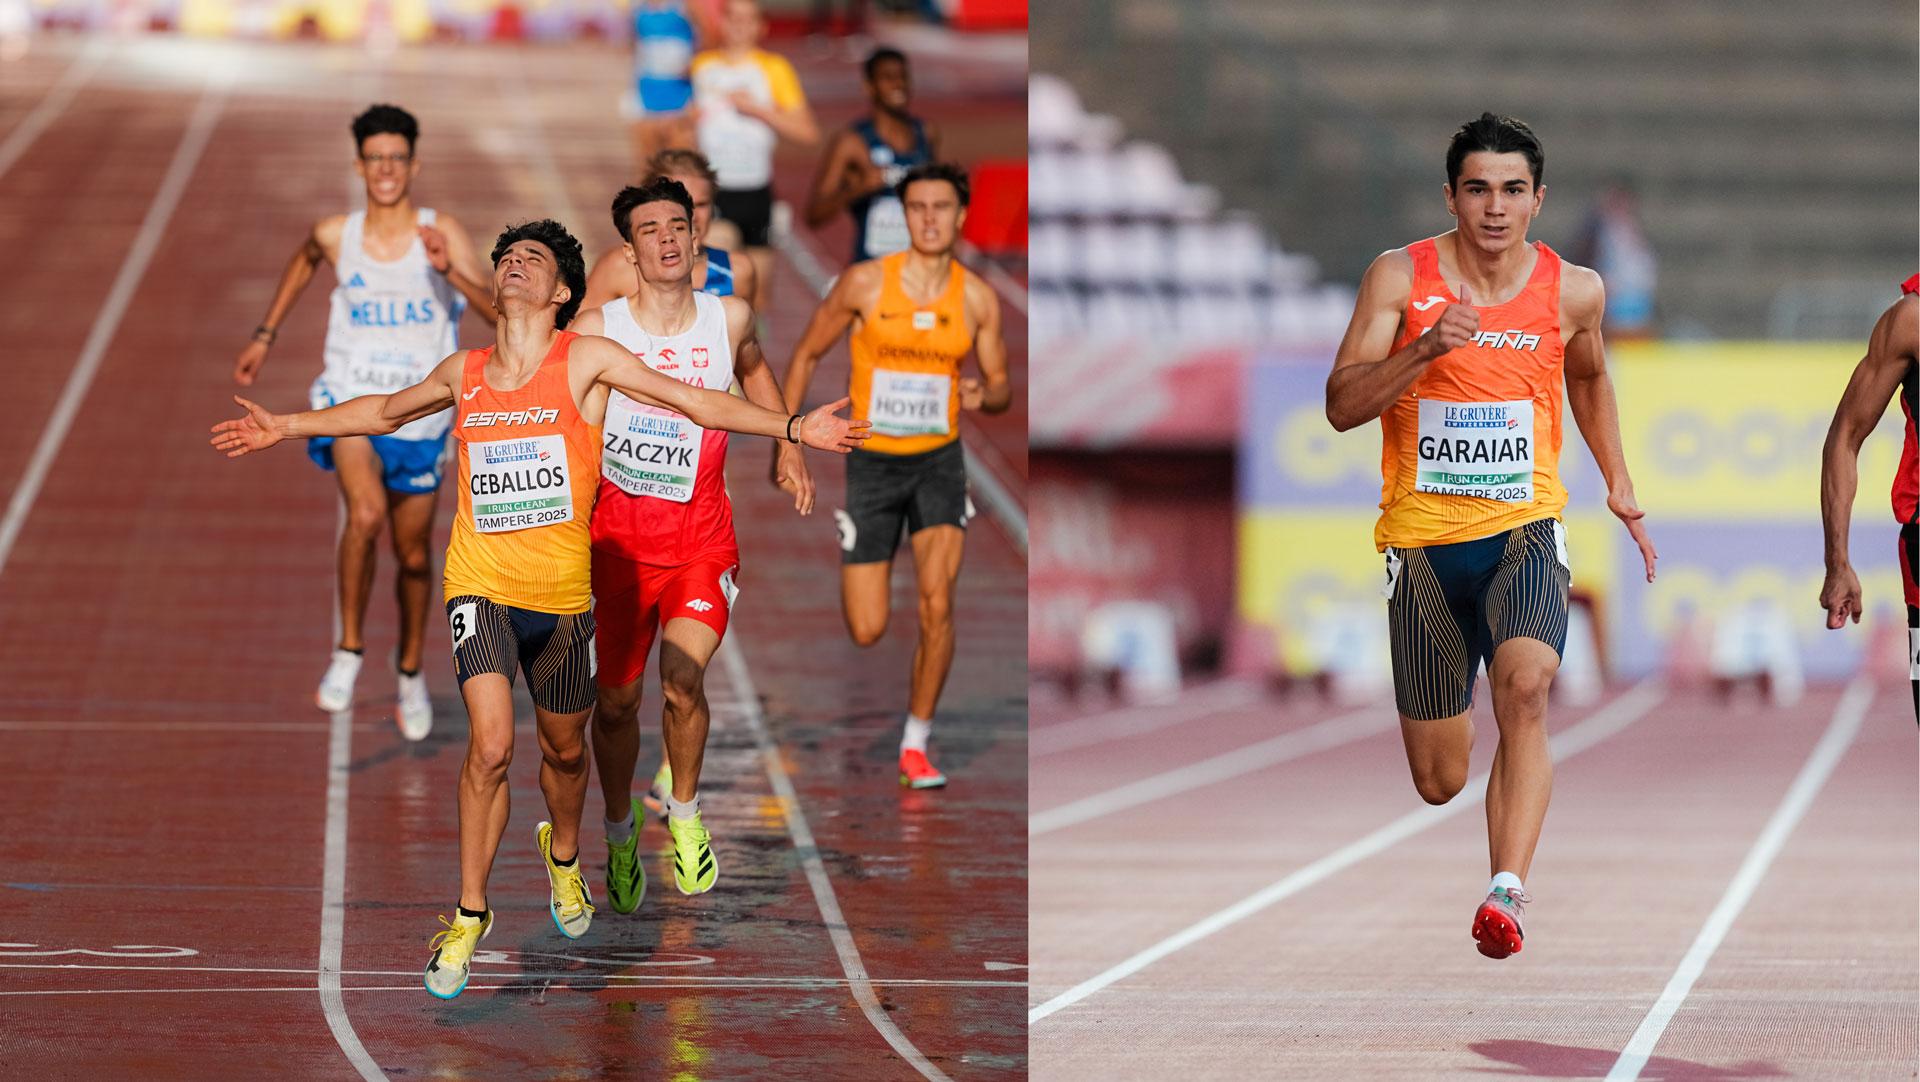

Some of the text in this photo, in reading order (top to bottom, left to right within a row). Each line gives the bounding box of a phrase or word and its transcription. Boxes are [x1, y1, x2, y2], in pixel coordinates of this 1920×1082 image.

[463, 406, 560, 428] ESPAÑA
[876, 397, 940, 419] HOYER
[1445, 405, 1507, 420] LE GRUYÈRE
[630, 415, 640, 426] LE
[484, 446, 493, 457] LE
[605, 432, 693, 467] ZACZYK
[1419, 436, 1528, 463] GARAIAR
[471, 466, 564, 495] CEBALLOS
[607, 467, 686, 498] TAMPERE 2025
[1447, 473, 1470, 484] RUN
[1495, 487, 1527, 500] 2025
[492, 503, 512, 513] RUN
[477, 509, 567, 528] TAMPERE 2025
[453, 612, 466, 642] 8
